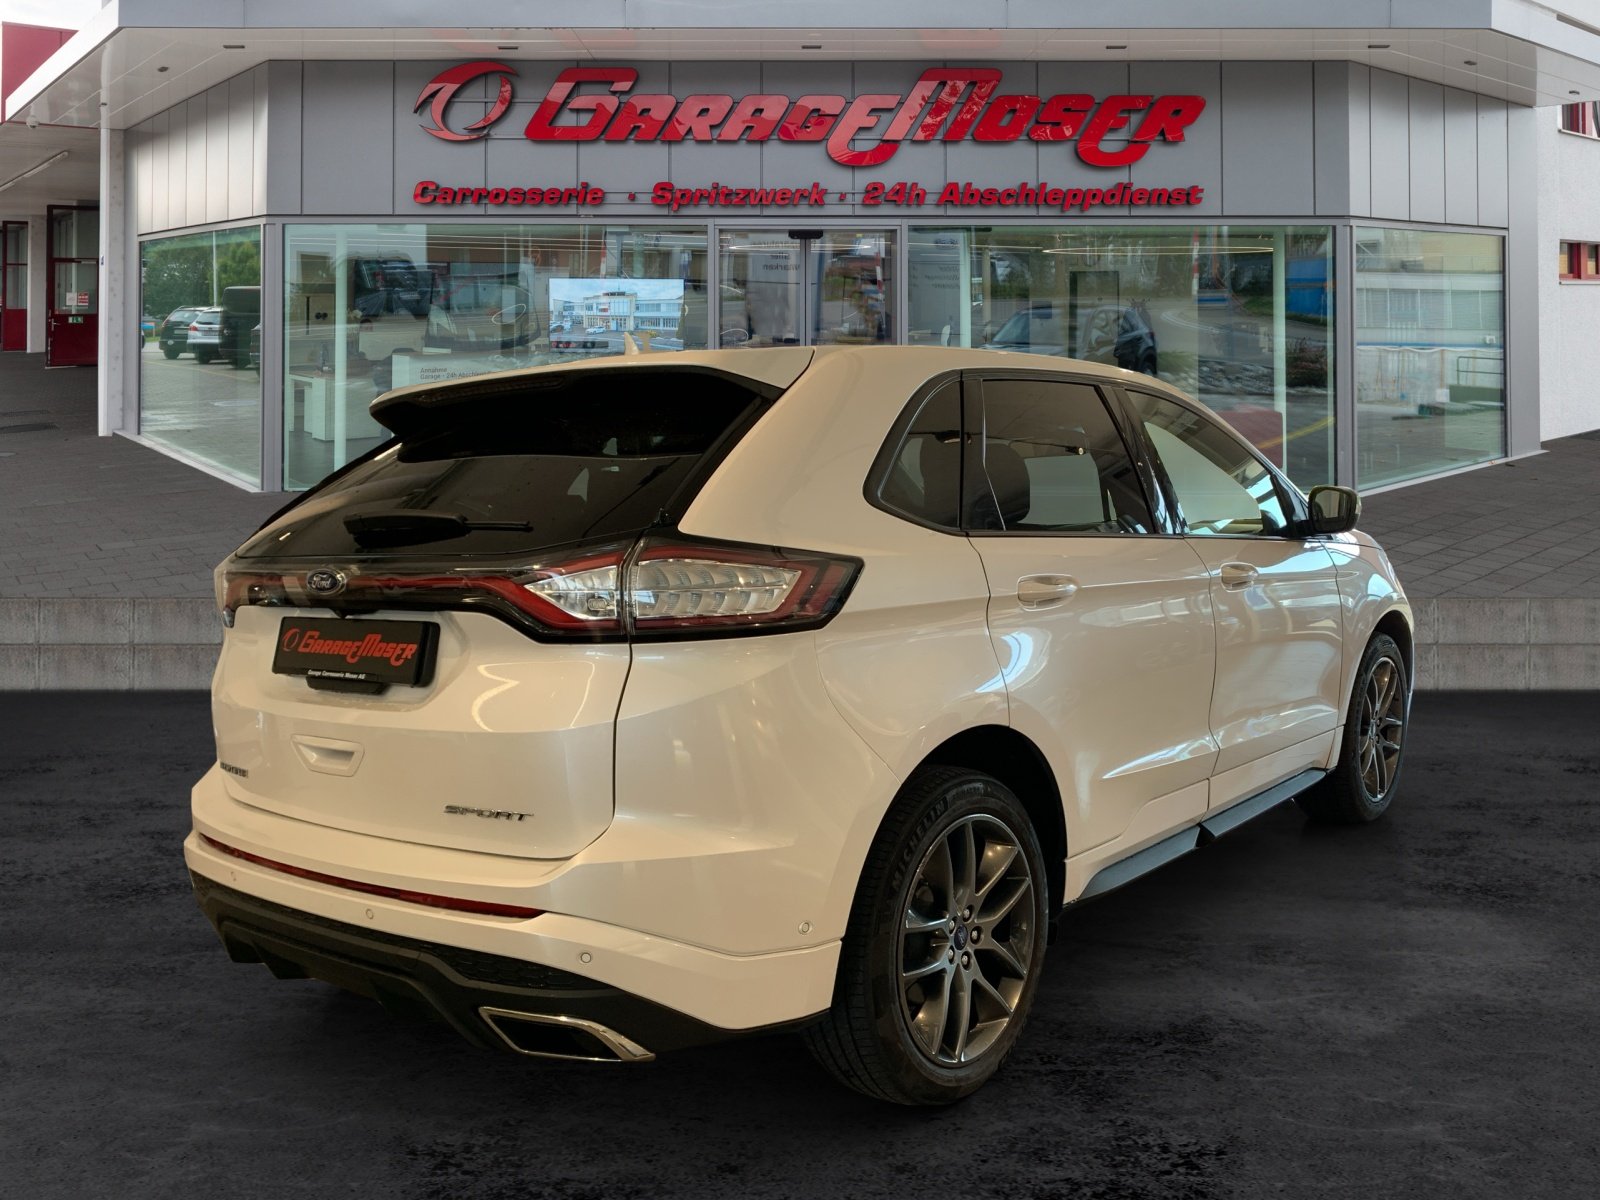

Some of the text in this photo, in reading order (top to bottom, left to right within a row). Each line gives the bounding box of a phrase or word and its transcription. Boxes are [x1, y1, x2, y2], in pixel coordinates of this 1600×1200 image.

[413, 181, 1205, 212] Carrosserie Spritzwerk 24h Abschleppdienst
[311, 573, 332, 589] Ford
[891, 800, 945, 891] MICHELIN
